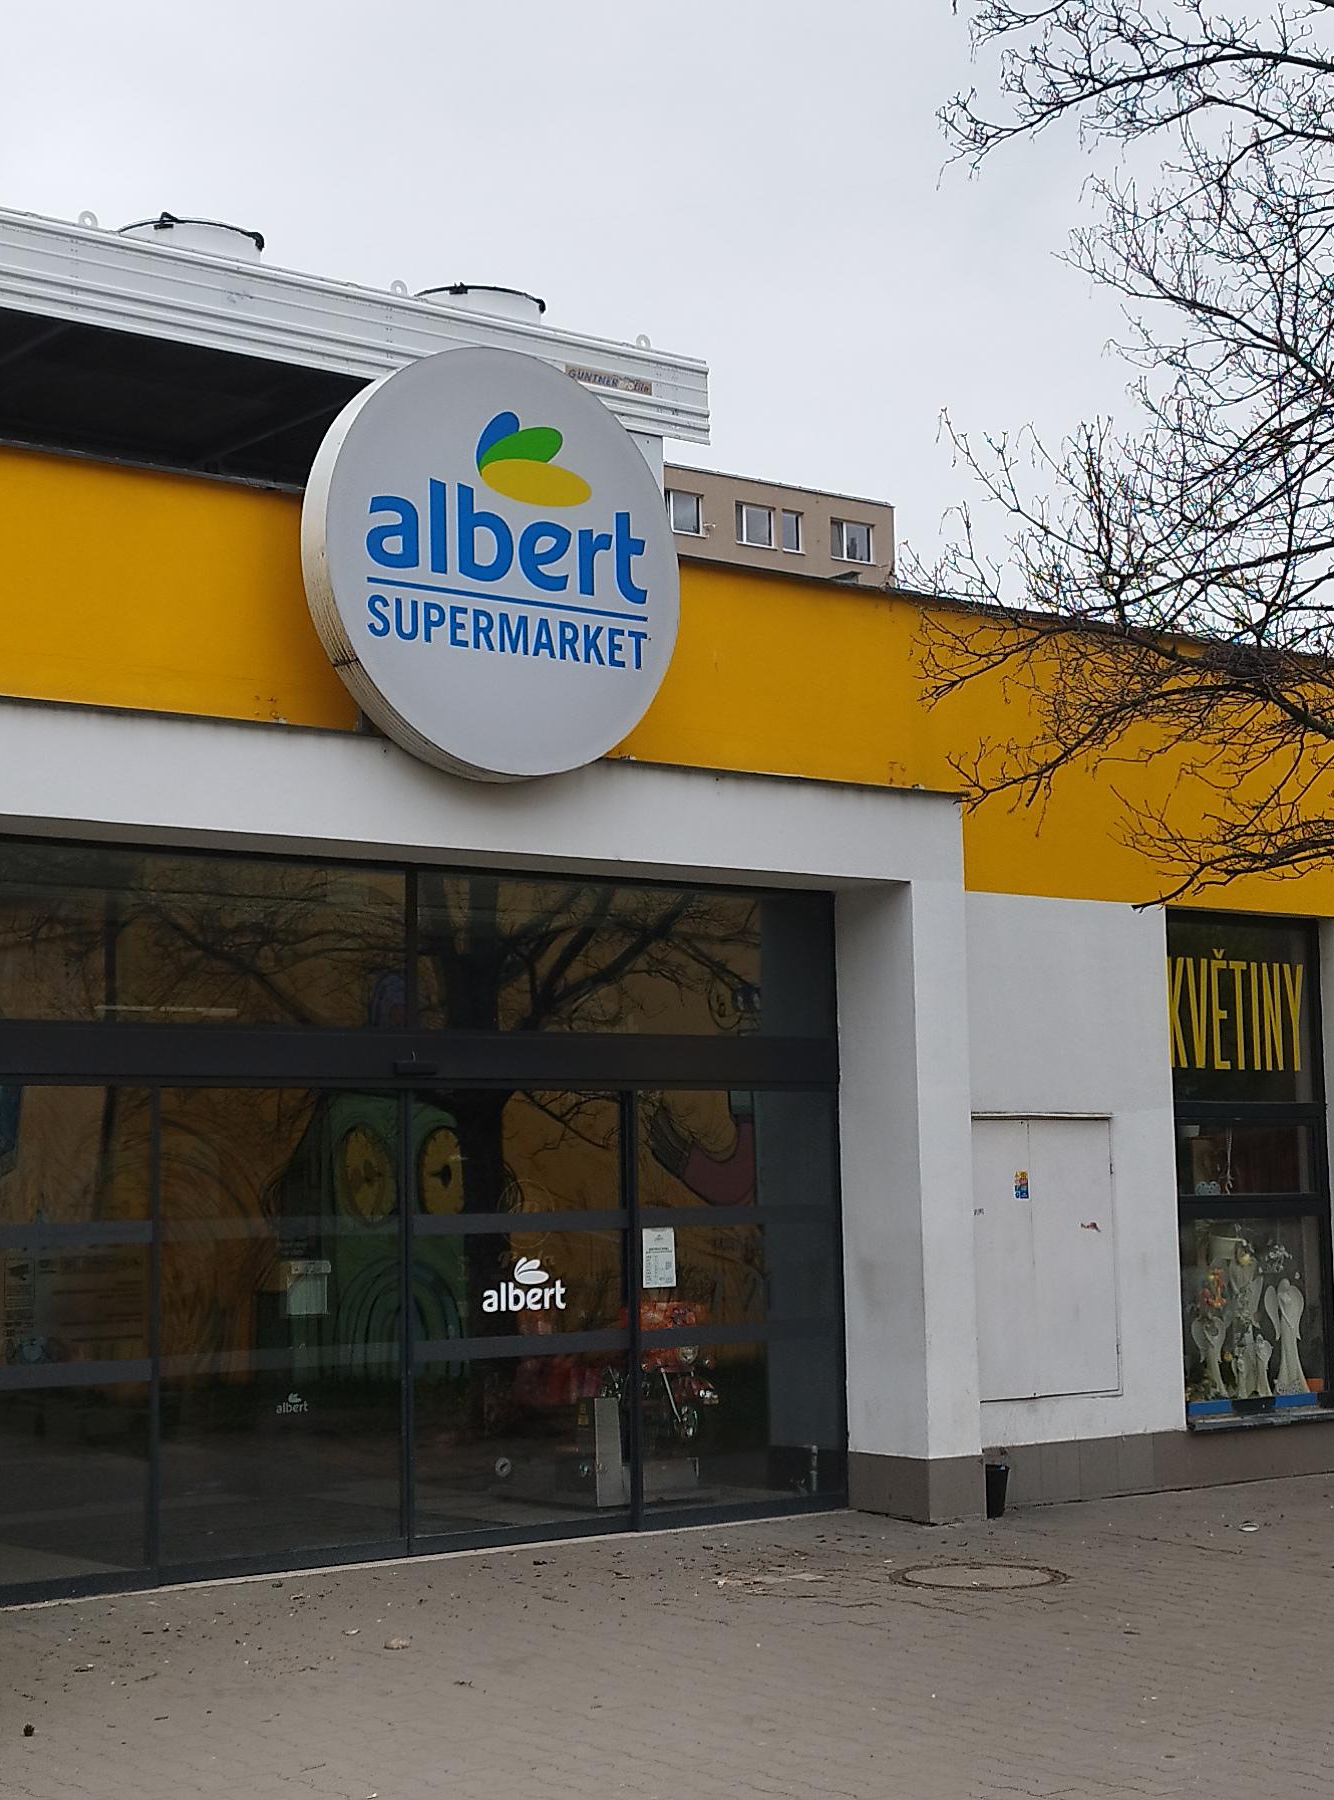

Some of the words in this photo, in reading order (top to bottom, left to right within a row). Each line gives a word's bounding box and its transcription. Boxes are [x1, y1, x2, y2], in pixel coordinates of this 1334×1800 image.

[365, 477, 648, 605] albert
[367, 594, 648, 670] SUPERMARKET
[1168, 948, 1304, 1071] KVĚTINY
[482, 1279, 567, 1313] albert
[275, 1400, 309, 1414] albert
